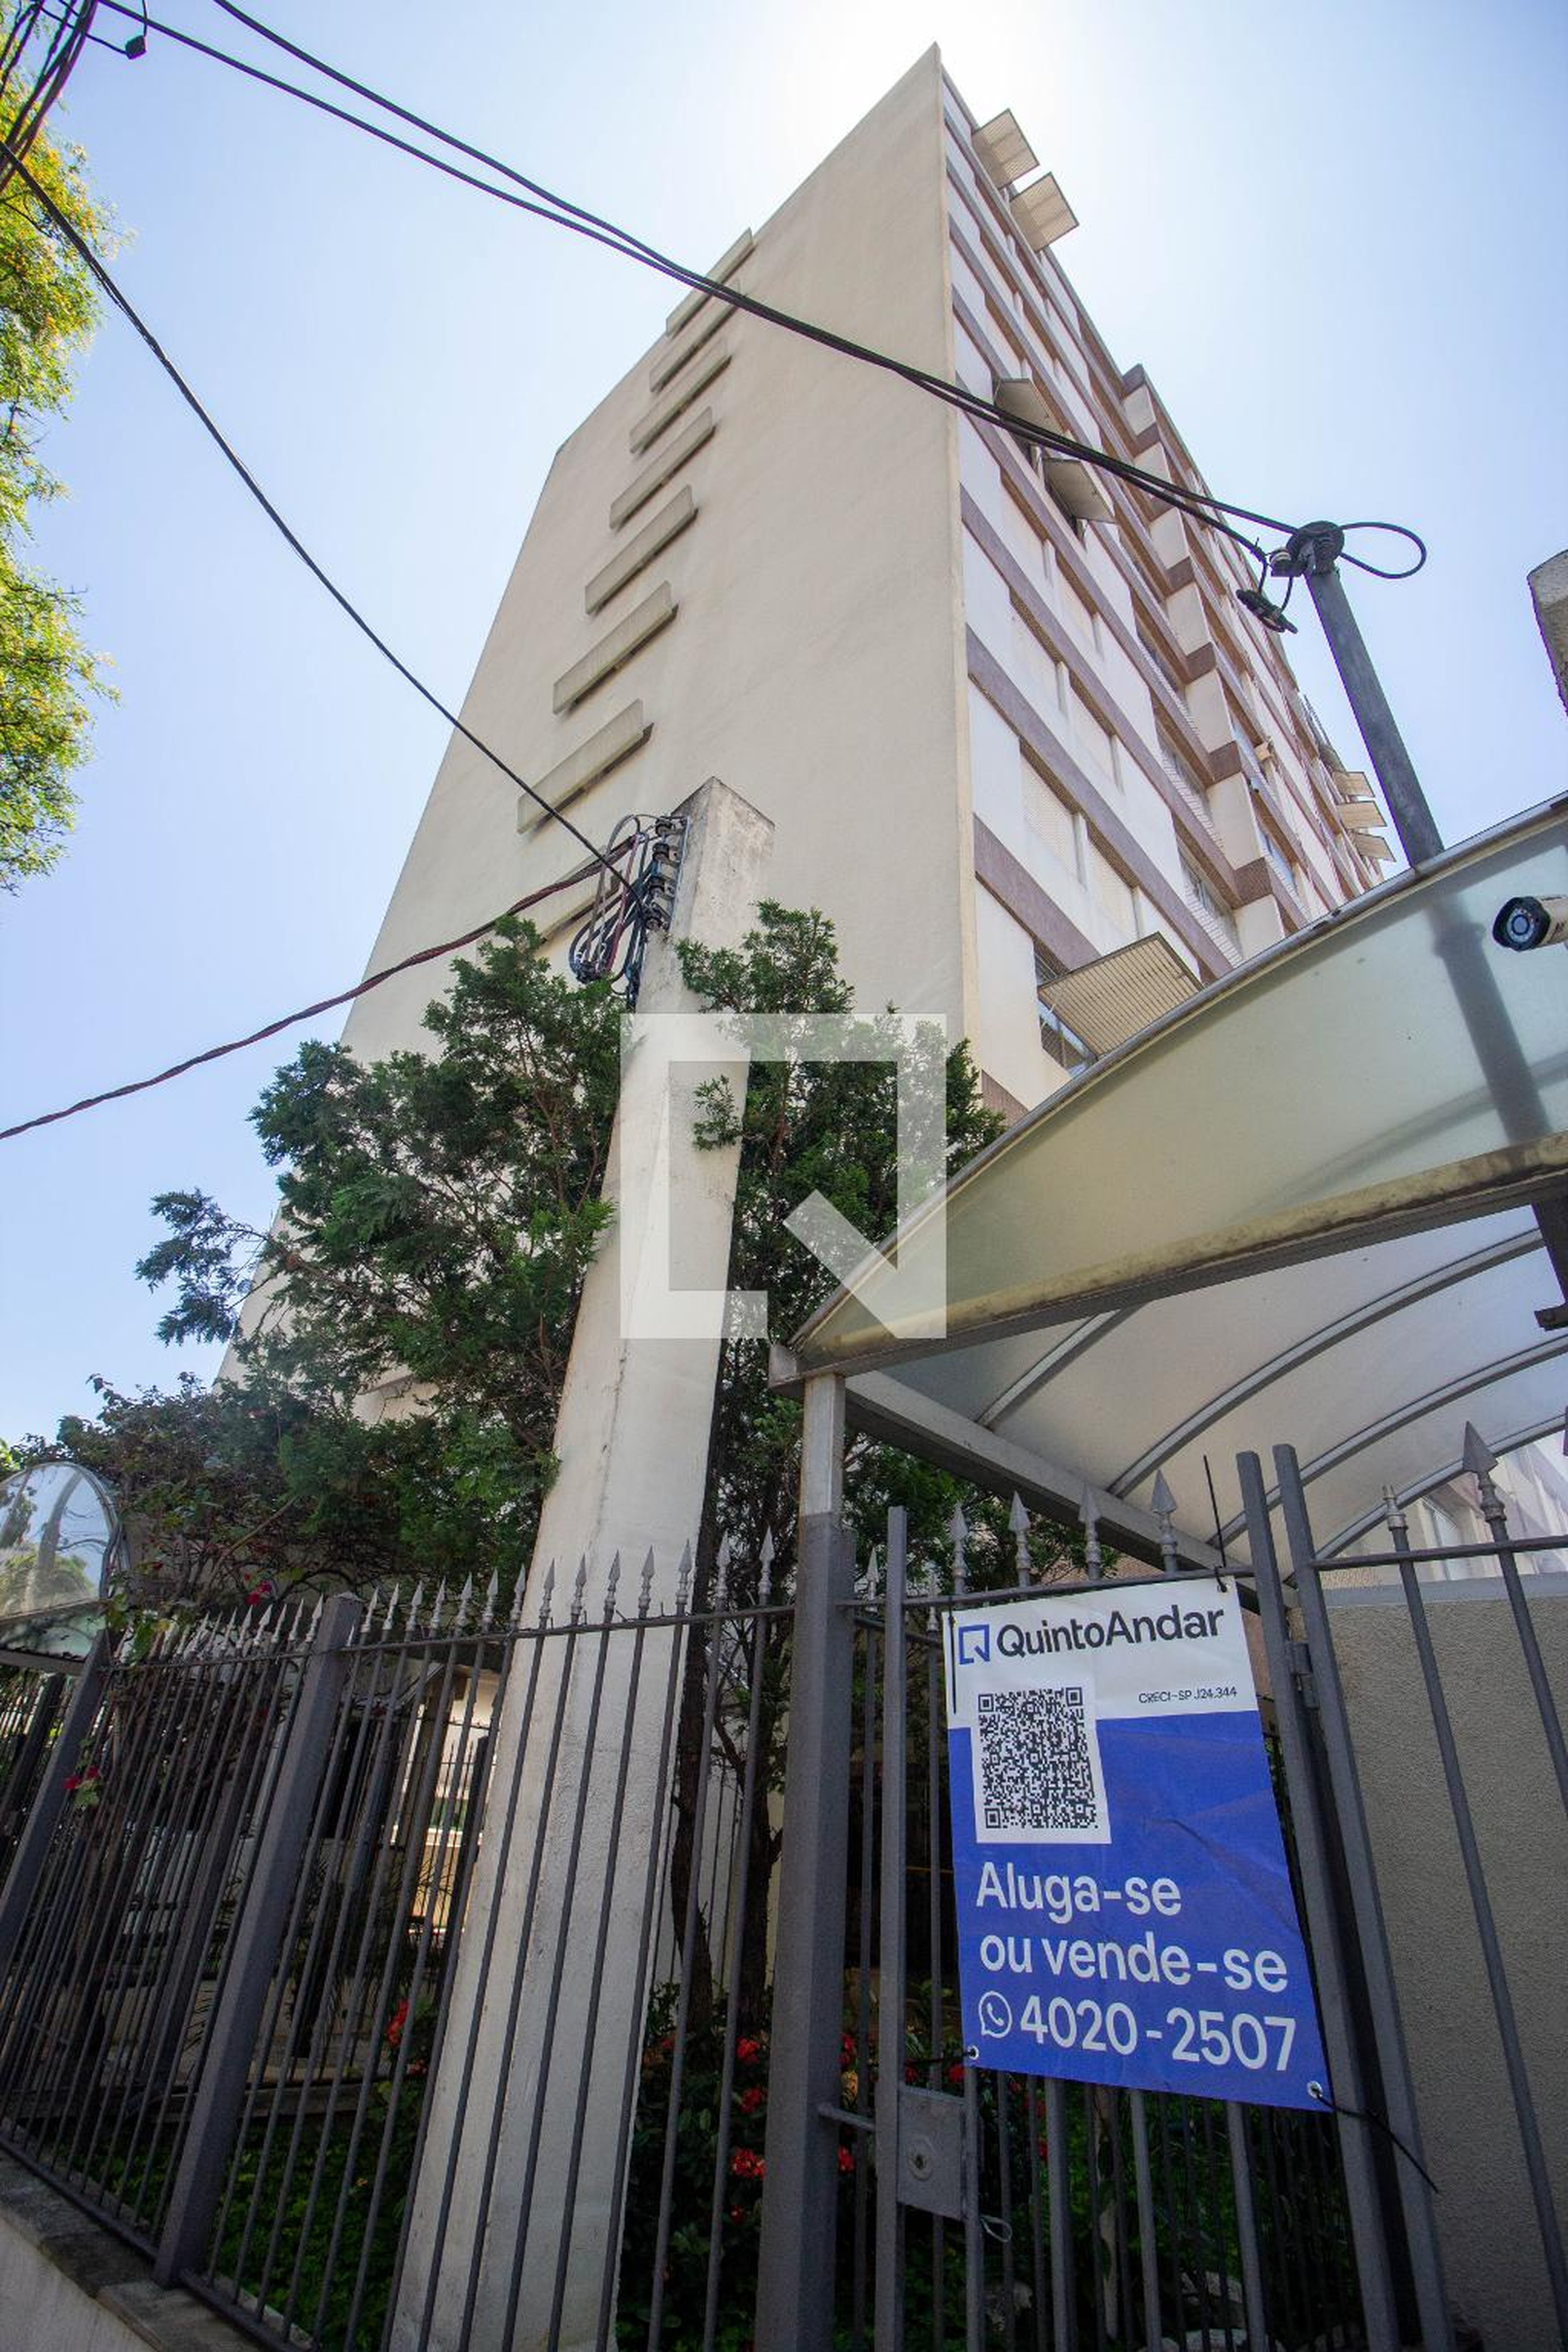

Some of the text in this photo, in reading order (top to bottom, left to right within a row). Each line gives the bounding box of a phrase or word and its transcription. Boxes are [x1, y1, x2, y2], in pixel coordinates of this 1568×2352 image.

[996, 1604, 1224, 1658] QuintoAndar
[976, 1862, 1181, 1924] Aluga-se
[980, 1932, 1287, 1992] ou vende-se
[1020, 1996, 1295, 2071] 4020-2507
